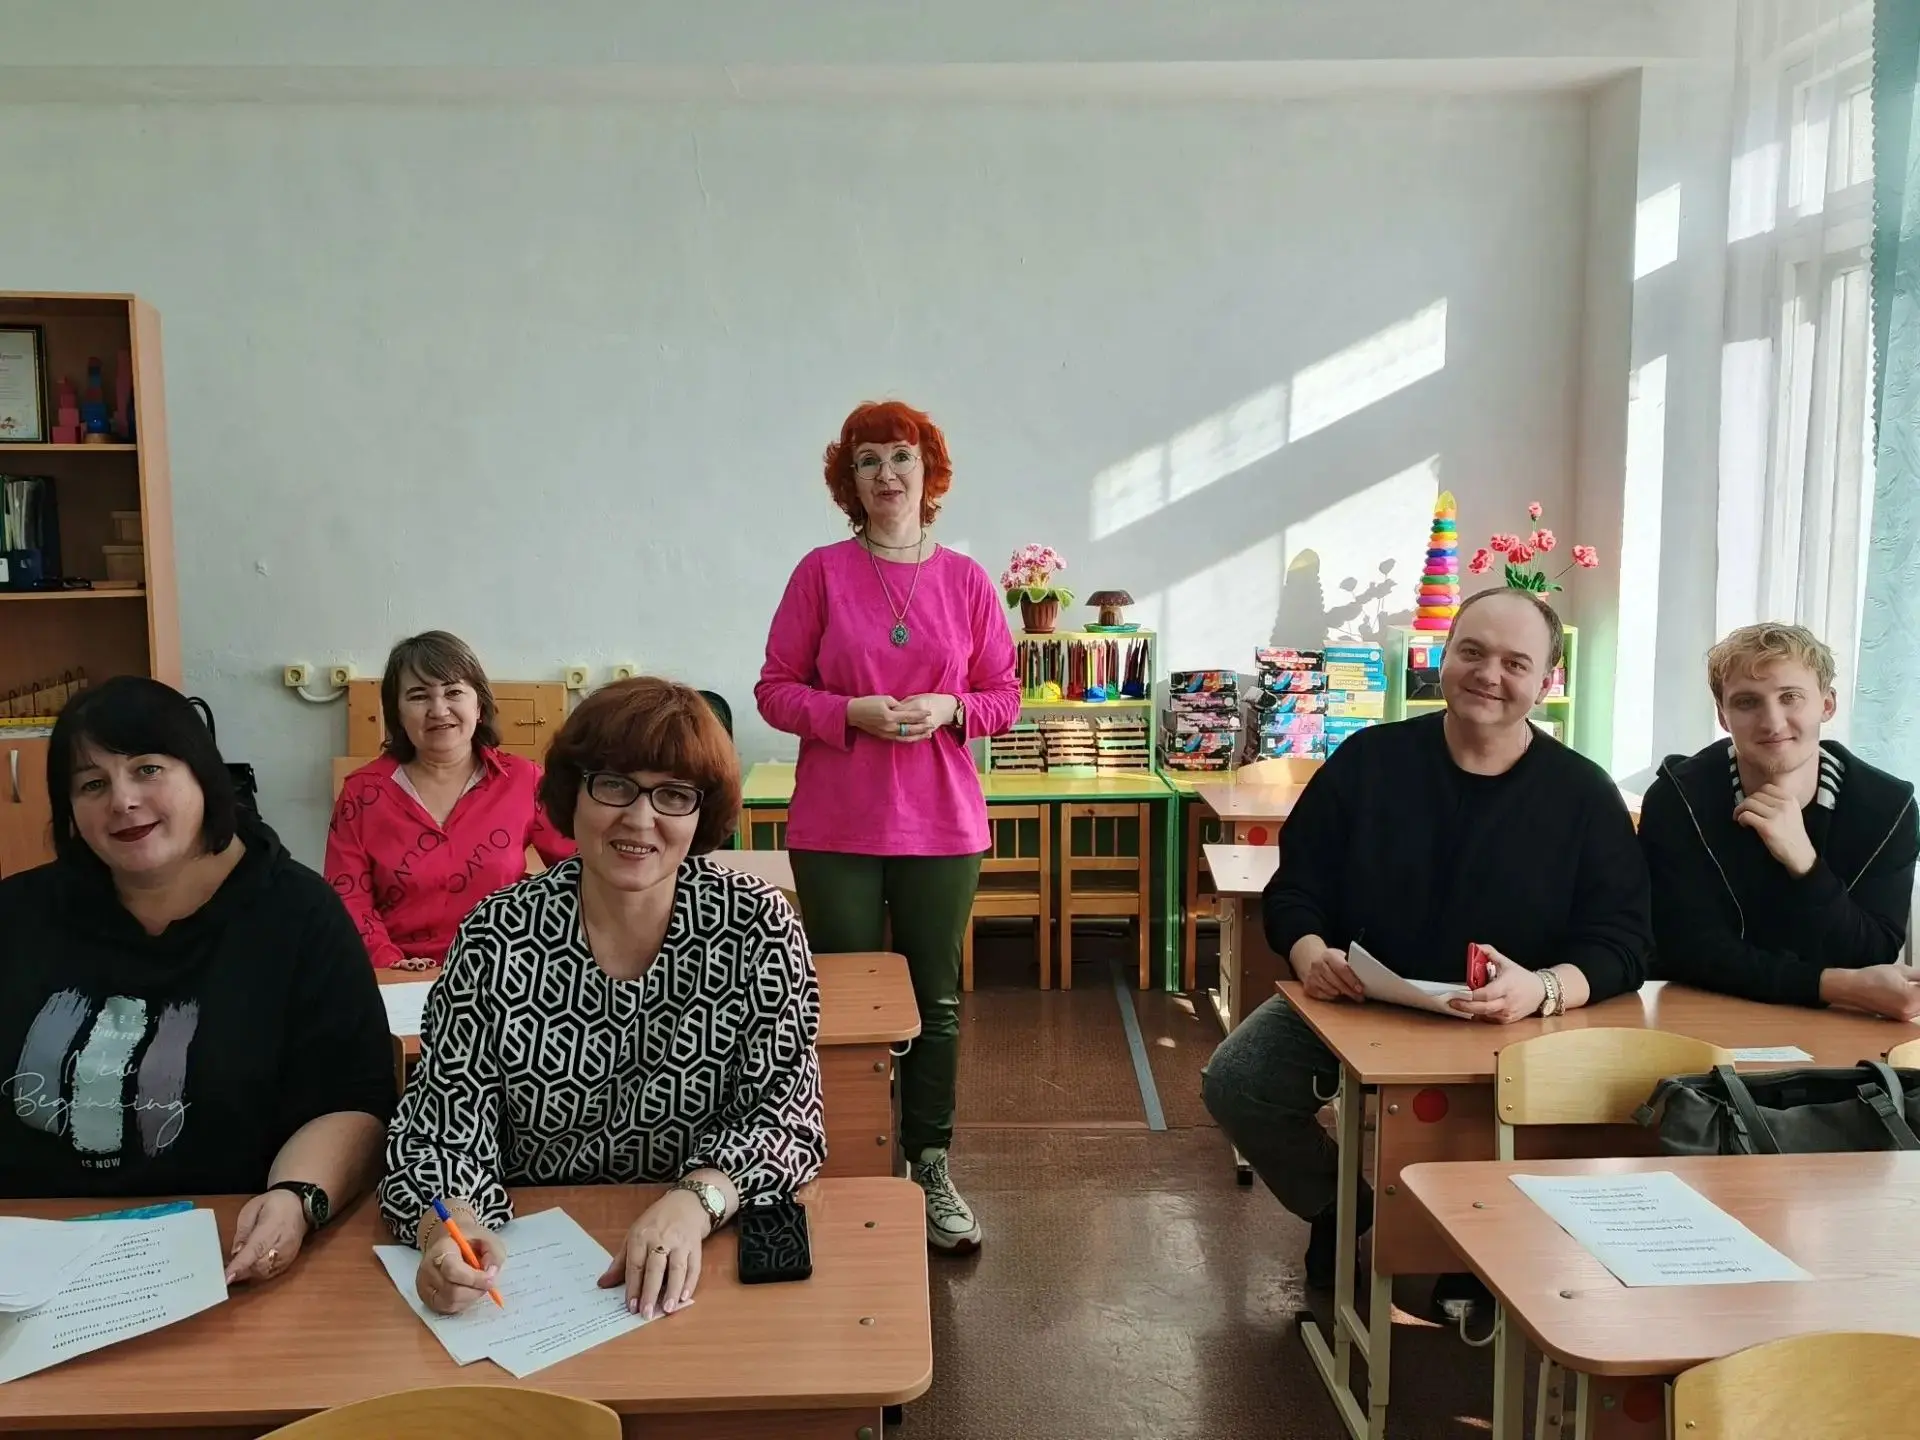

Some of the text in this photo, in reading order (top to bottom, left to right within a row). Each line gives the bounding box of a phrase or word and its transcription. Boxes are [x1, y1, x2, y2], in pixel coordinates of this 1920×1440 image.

[1, 1071, 192, 1148] Beginning
[81, 1157, 121, 1169] IS NOW
